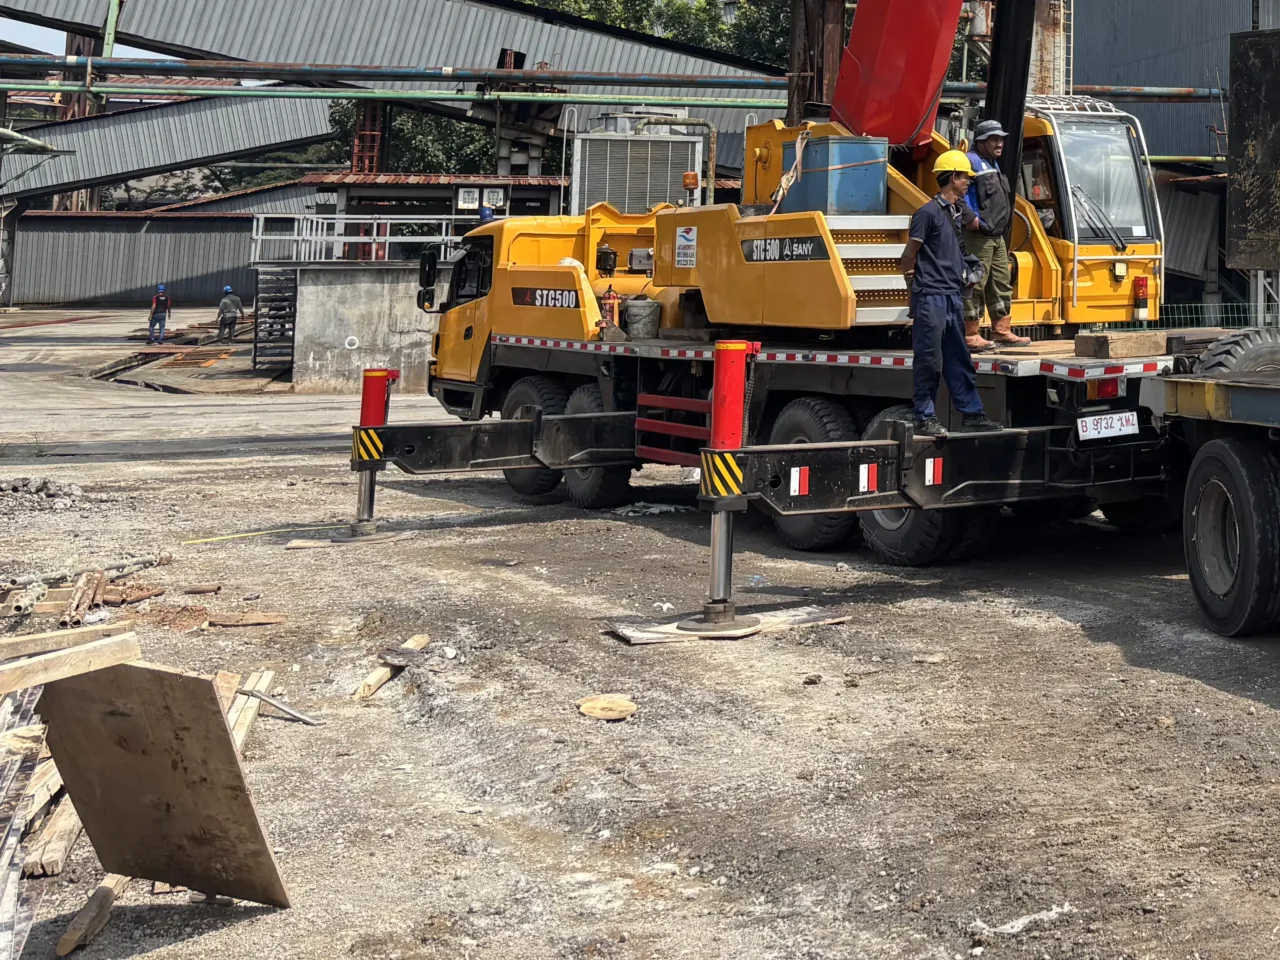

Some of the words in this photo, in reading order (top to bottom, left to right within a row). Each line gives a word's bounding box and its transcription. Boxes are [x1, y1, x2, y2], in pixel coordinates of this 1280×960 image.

[793, 243, 813, 255] SANY
[535, 290, 576, 308] STC500
[1081, 420, 1088, 433] B
[1092, 416, 1115, 431] 9732
